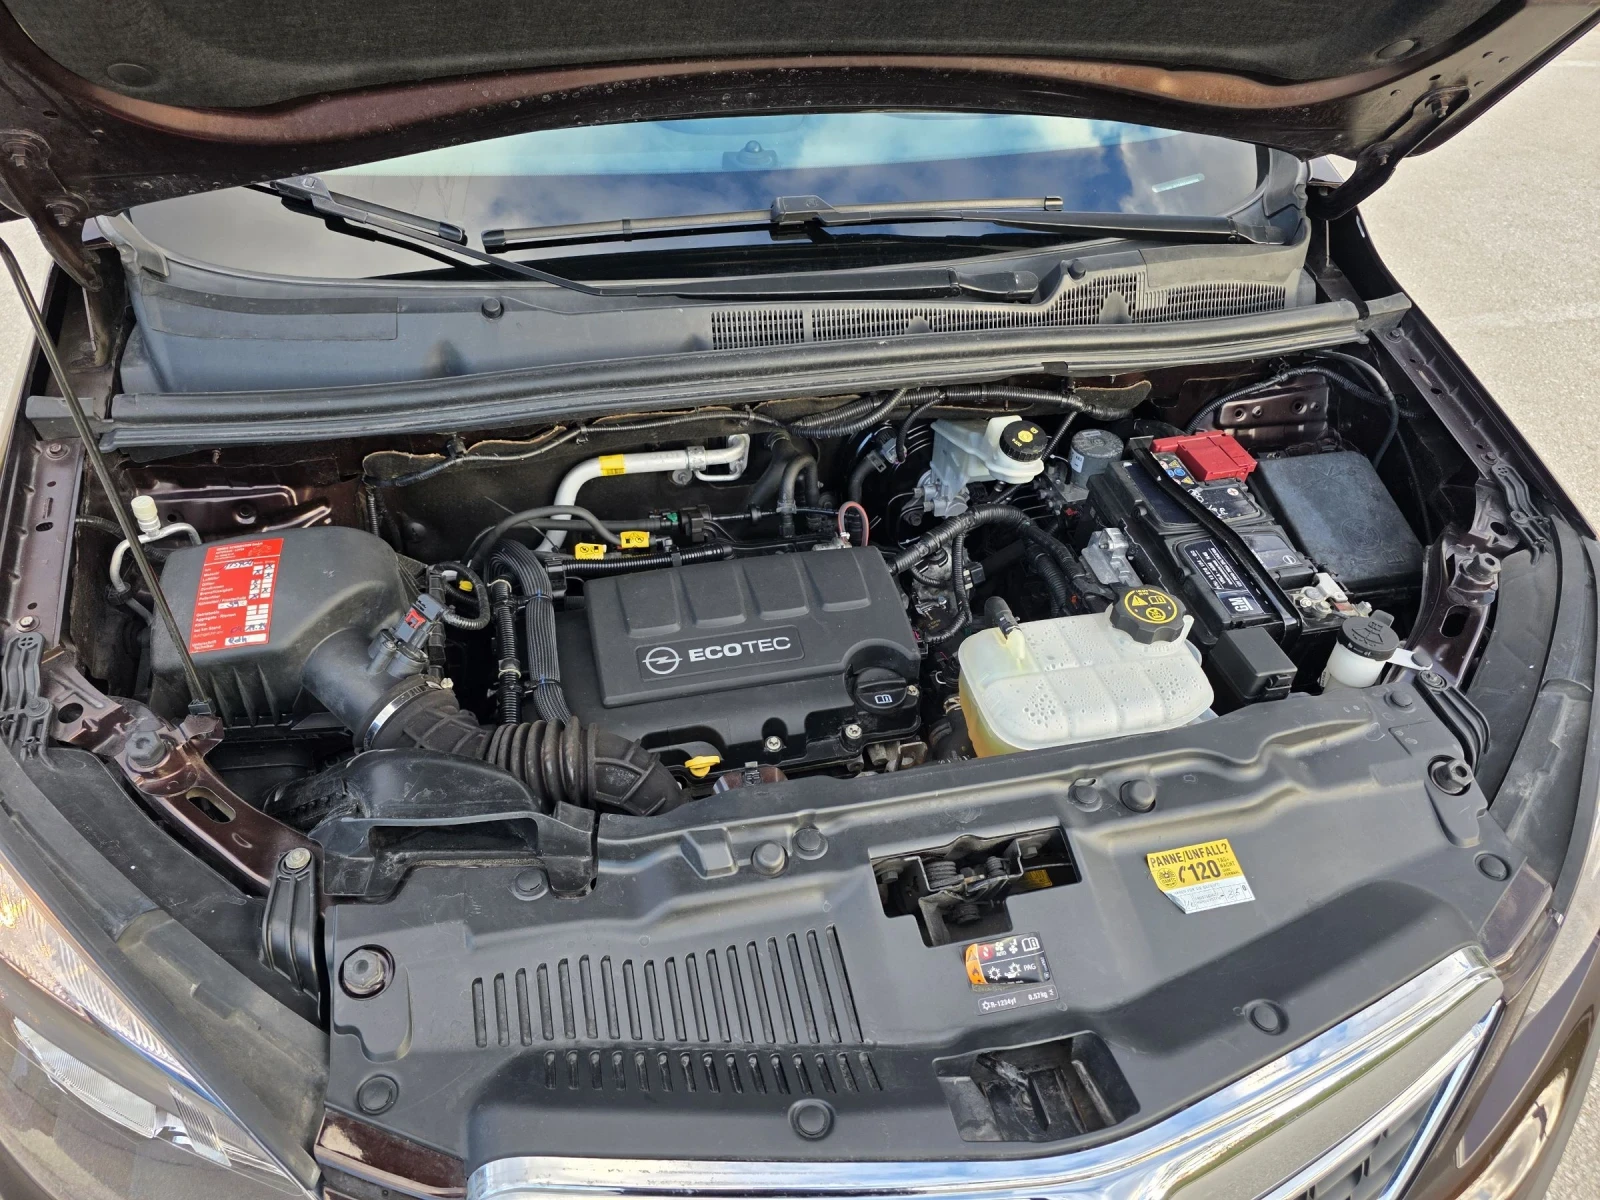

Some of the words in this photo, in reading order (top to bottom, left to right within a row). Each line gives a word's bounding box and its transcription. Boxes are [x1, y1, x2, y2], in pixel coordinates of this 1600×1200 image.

[1228, 597, 1250, 612] GM
[688, 636, 792, 663] ECOTEC
[1149, 842, 1229, 868] PANNE/UNFALL?
[1187, 859, 1221, 881] 120
[1023, 963, 1037, 971] PAG
[990, 997, 1017, 1008] R-1234yf
